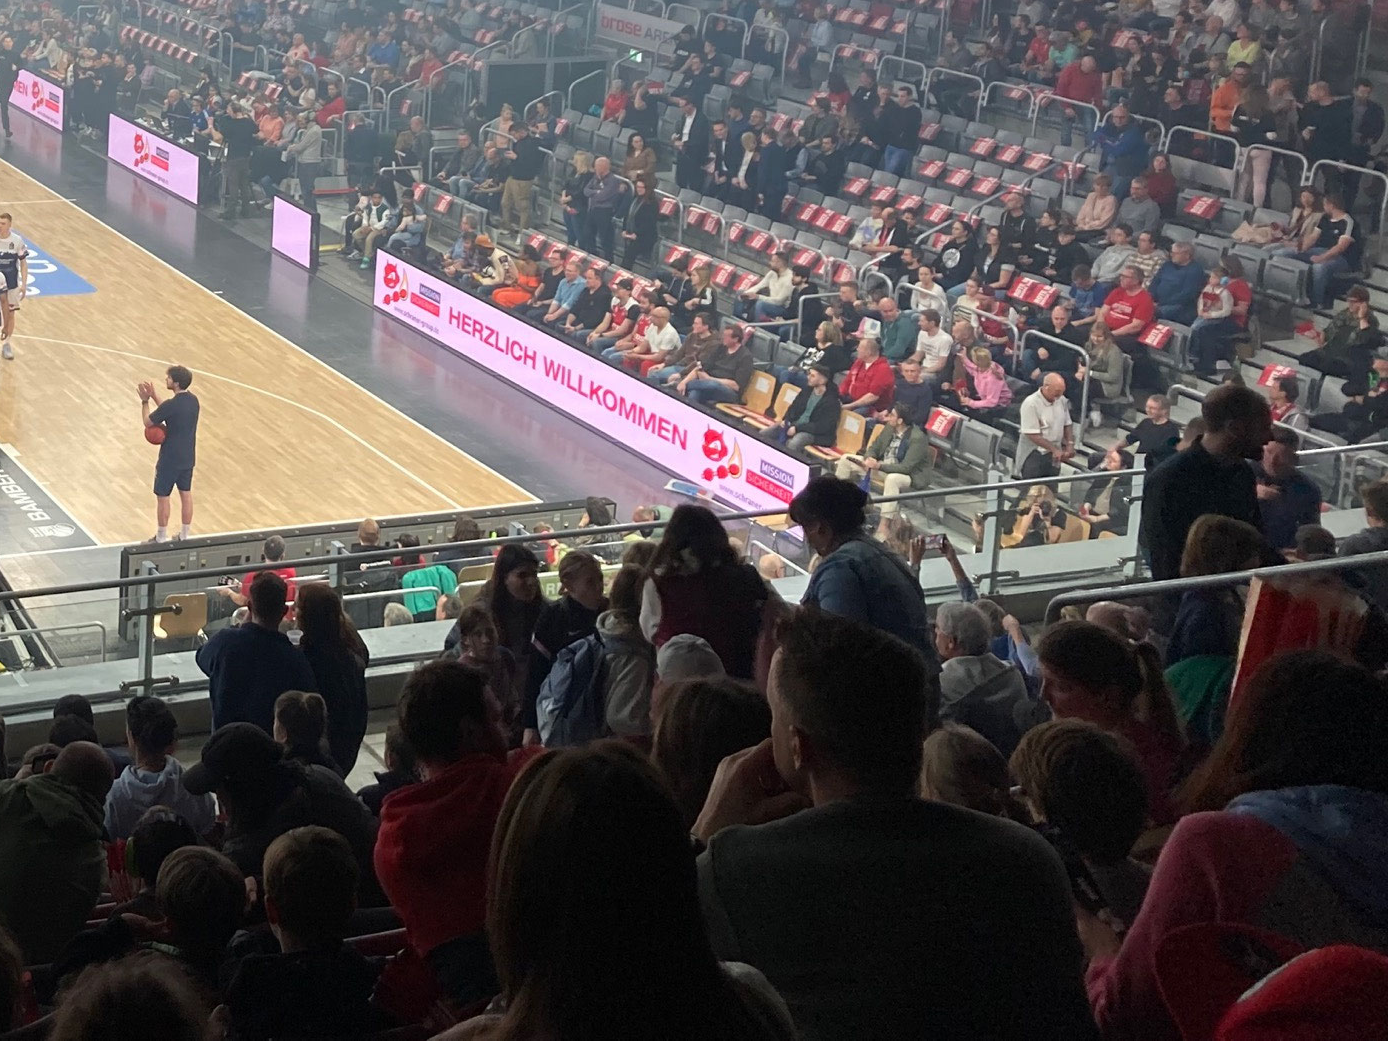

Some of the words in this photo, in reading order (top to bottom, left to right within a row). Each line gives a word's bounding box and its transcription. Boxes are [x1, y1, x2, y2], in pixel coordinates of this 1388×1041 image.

[600, 14, 643, 37] brose
[448, 306, 537, 370] HERZLICH
[542, 356, 689, 451] WILLKOMMEN
[747, 470, 794, 503] SICHERHEIT
[760, 460, 795, 488] MISSION
